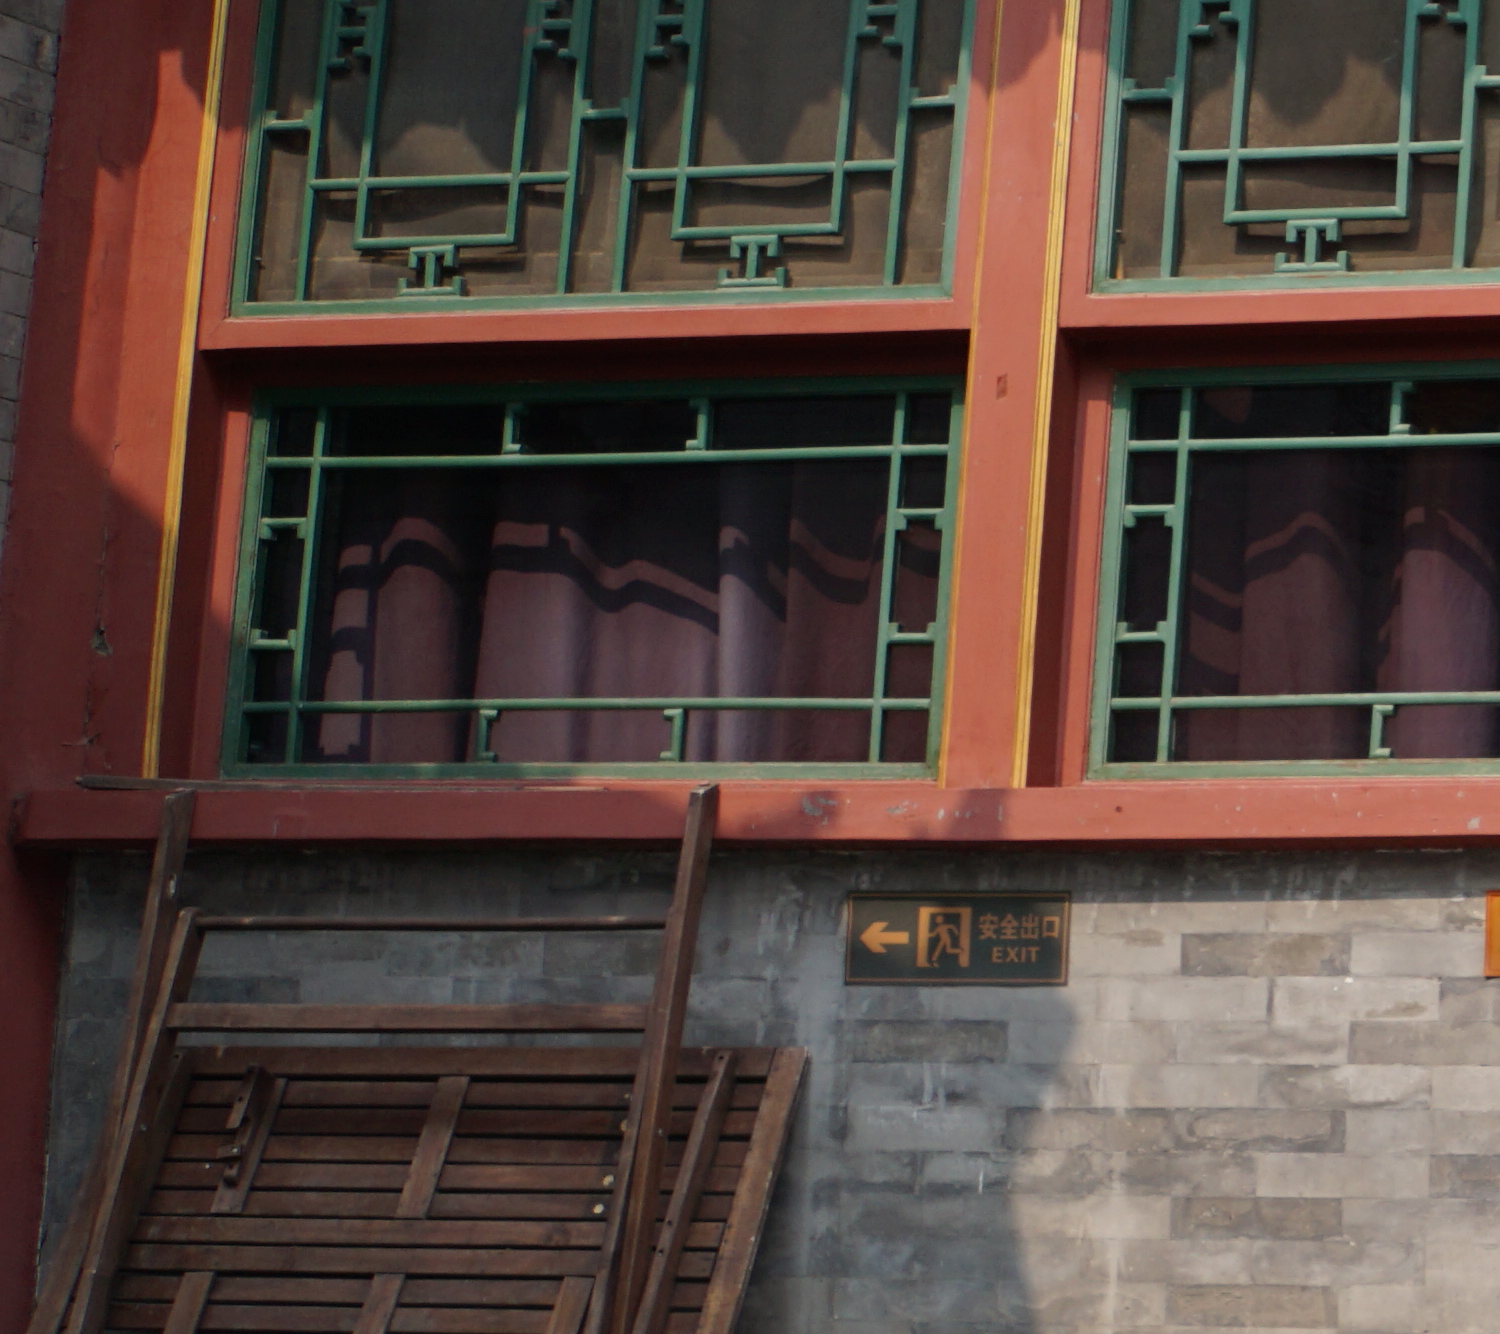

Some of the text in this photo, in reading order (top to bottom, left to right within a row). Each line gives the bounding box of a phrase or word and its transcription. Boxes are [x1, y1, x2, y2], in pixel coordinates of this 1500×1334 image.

[978, 912, 1060, 940] 安全出口
[991, 946, 1040, 964] EXIT
